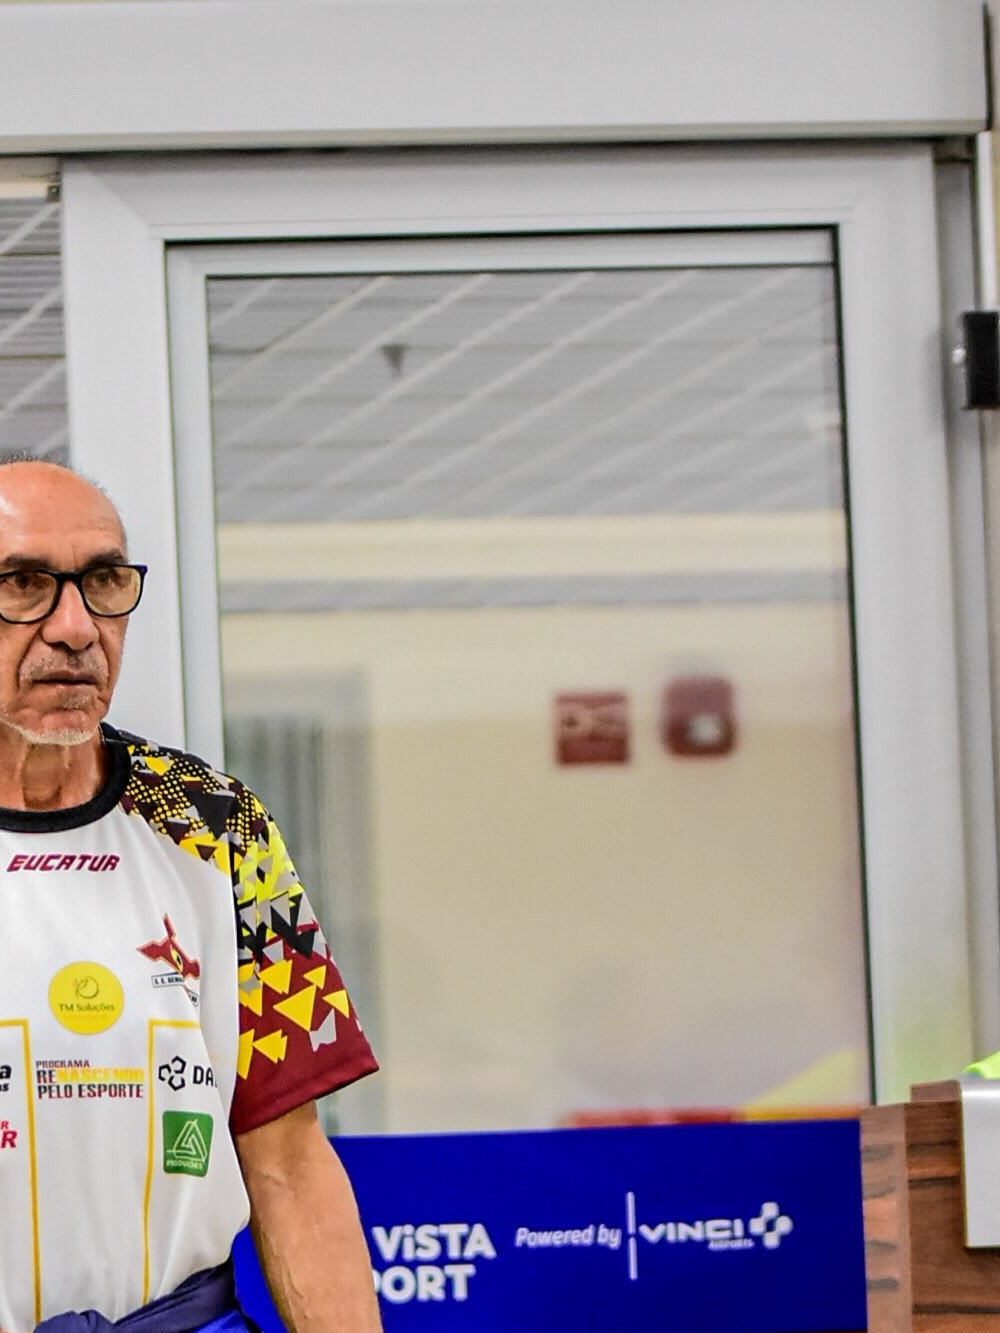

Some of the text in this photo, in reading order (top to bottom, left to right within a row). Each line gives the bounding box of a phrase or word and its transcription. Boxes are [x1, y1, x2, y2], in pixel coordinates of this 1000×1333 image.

[6, 853, 121, 873] EUCATUR
[58, 1003, 74, 1012] TM
[35, 1060, 90, 1069] PROGRAMA
[192, 1065, 217, 1088] DA
[37, 1083, 144, 1099] PELO ESPORTE
[515, 1218, 745, 1250] Powered by VINCI
